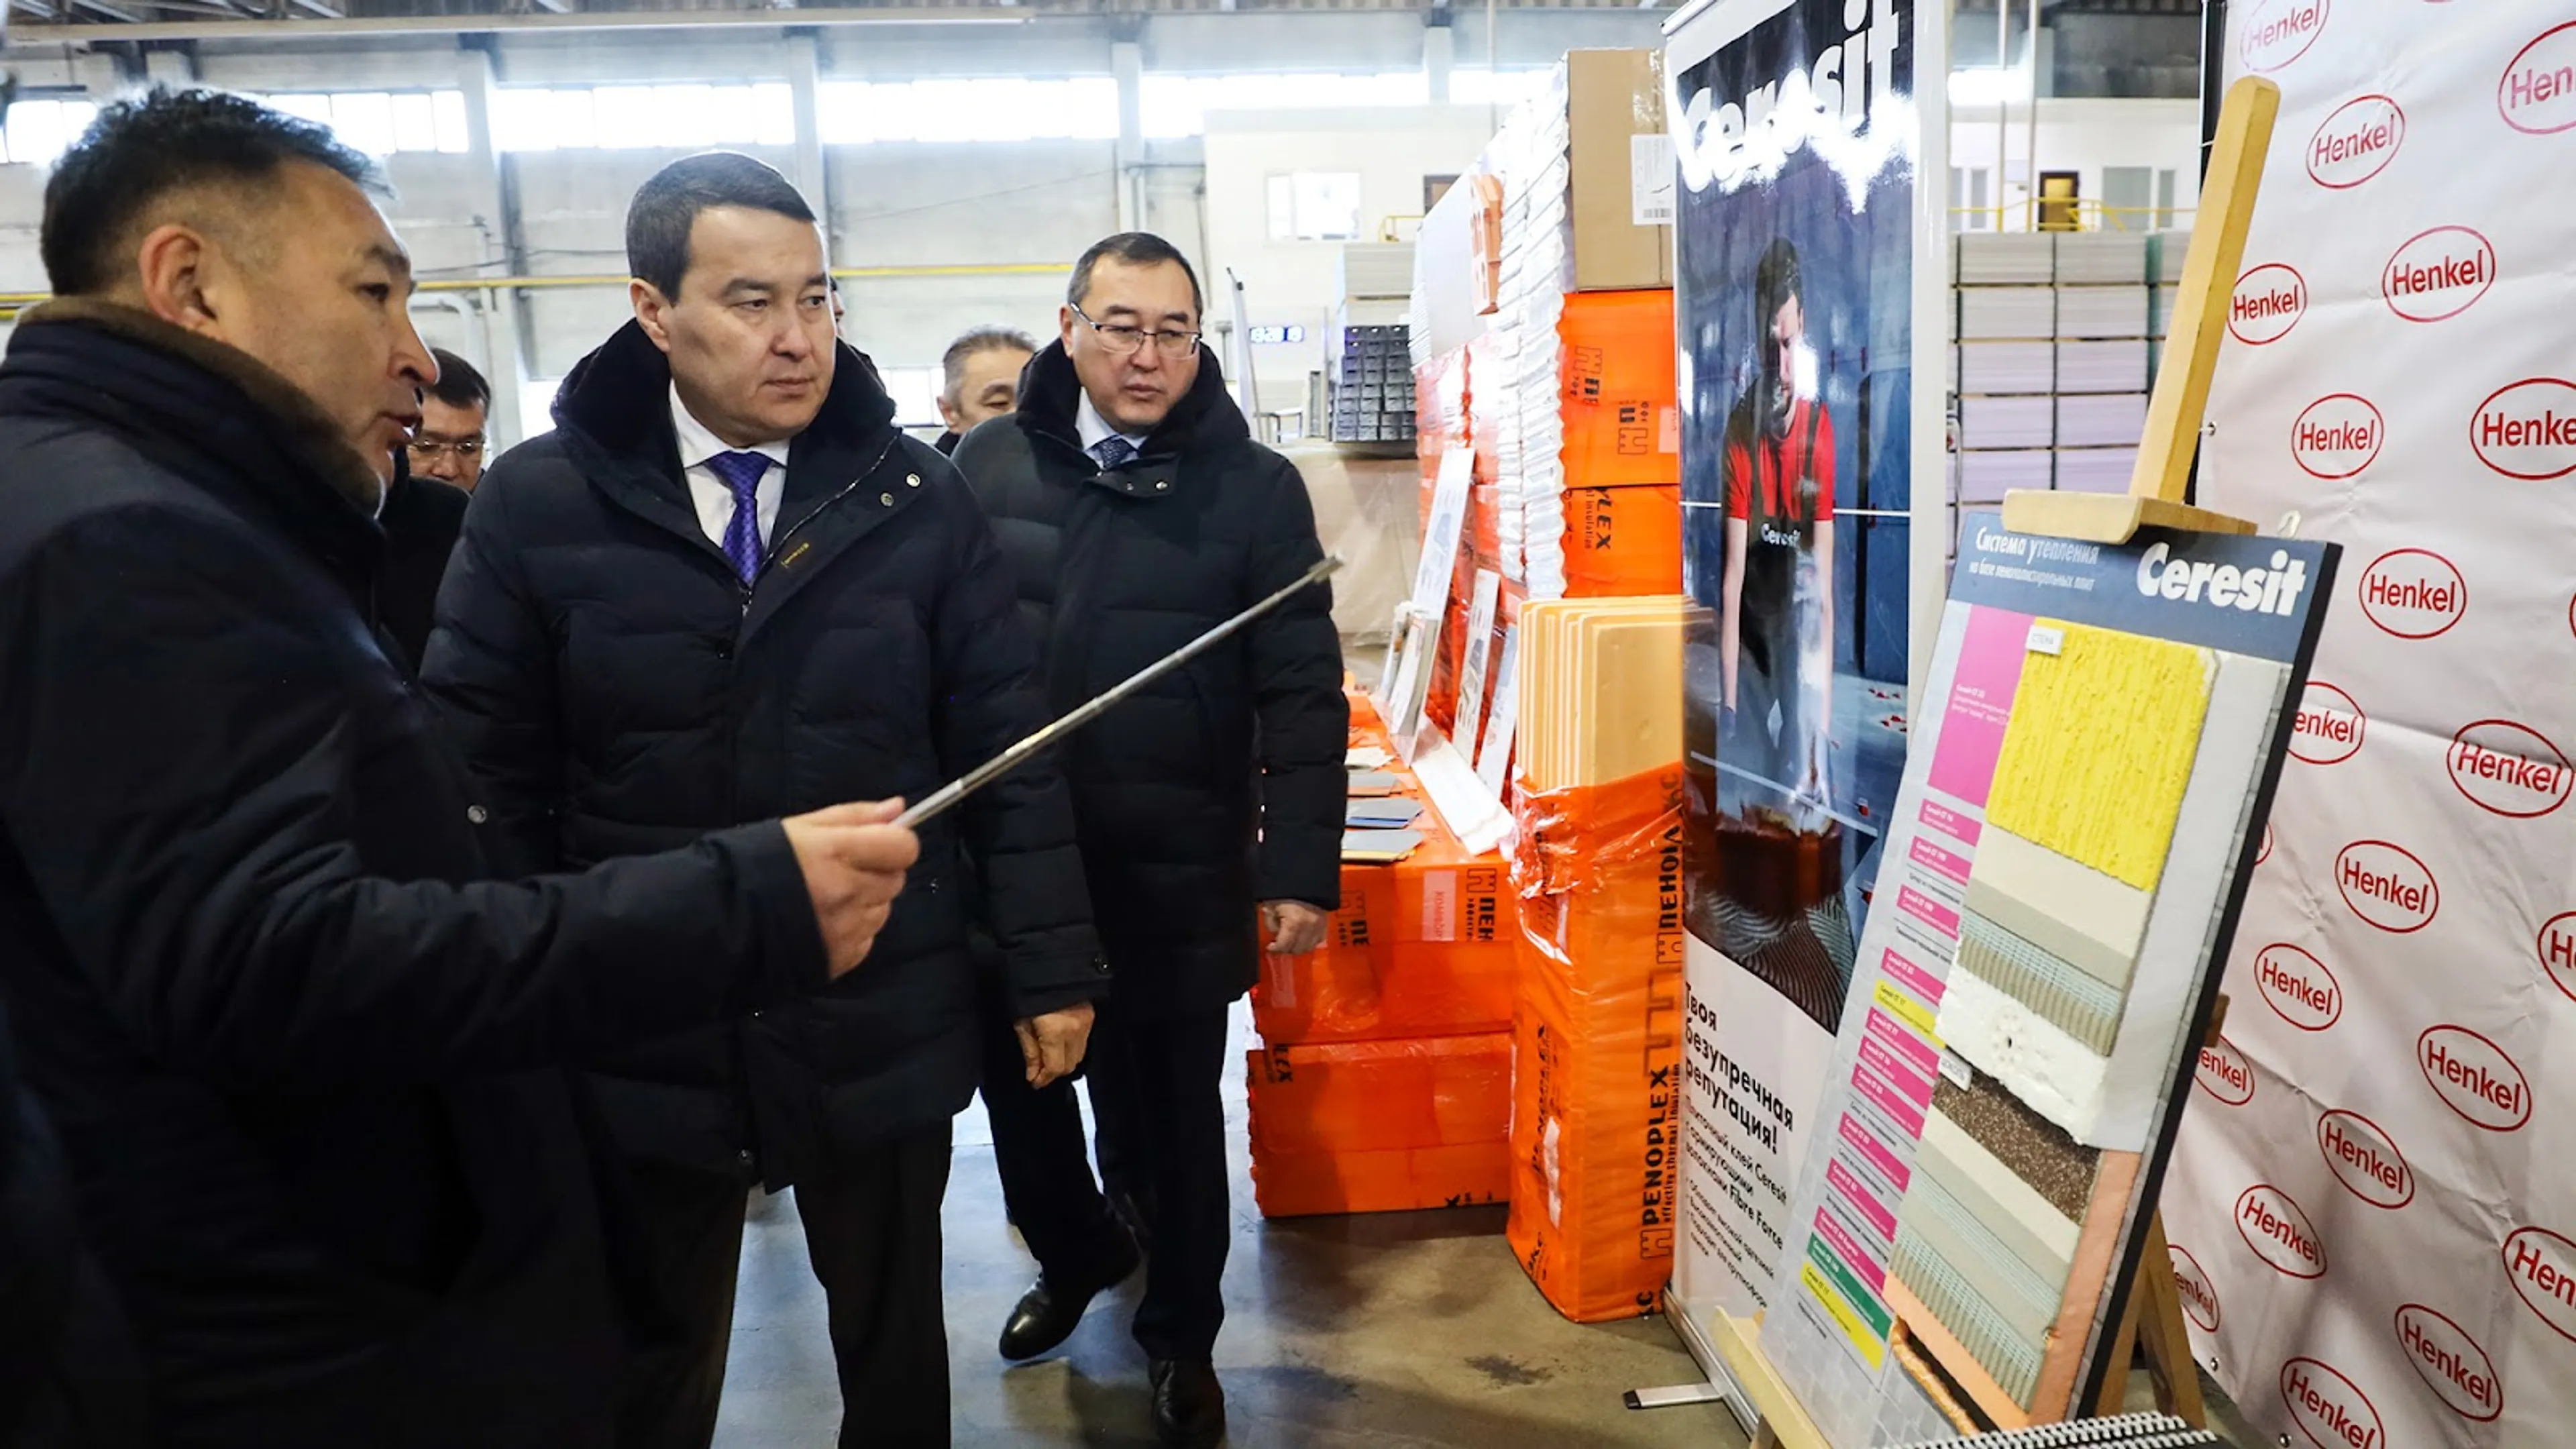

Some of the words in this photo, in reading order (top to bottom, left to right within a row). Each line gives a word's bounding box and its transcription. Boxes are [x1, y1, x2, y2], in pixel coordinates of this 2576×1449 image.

[2247, 0, 2320, 51] Henkel
[1682, 0, 1898, 193] Ceresit
[2510, 66, 2576, 109] Hen
[2314, 113, 2396, 168] Henkel
[2391, 249, 2485, 297] Henkel
[2233, 283, 2299, 321] Henkel
[2299, 418, 2375, 452] Henkel
[2481, 409, 2576, 447] Henke
[1760, 522, 1801, 549] Ceresit
[1975, 526, 2027, 556] Система
[2026, 539, 2101, 565] утепления
[2136, 542, 2306, 616] Ceresit
[2368, 574, 2456, 613] Henkel
[2293, 710, 2357, 743] enkel
[2457, 740, 2563, 795] Henkel
[2343, 857, 2429, 914] Henkel
[1685, 981, 1717, 1031] Твоя
[2261, 957, 2333, 1015] Henkel
[1685, 1016, 1793, 1132] безупречная
[2200, 1049, 2247, 1092] enkel
[2427, 1040, 2522, 1114] Henkel
[1685, 1056, 1778, 1155] репутация!
[1642, 1064, 1669, 1226] PENOPLEX
[1666, 1124, 1677, 1170] thermal
[2325, 1122, 2404, 1194] Henkel
[1663, 1175, 1675, 1223] effective
[1755, 1162, 1786, 1207] Ceresit
[1729, 1183, 1754, 1220] Fibre
[1756, 1209, 1783, 1250] Force
[2242, 1197, 2322, 1266] Henkel
[2171, 1261, 2214, 1320] enkel
[2512, 1239, 2576, 1308] Hen
[2404, 1322, 2492, 1407] Henkel
[2287, 1368, 2379, 1449] Henkel
